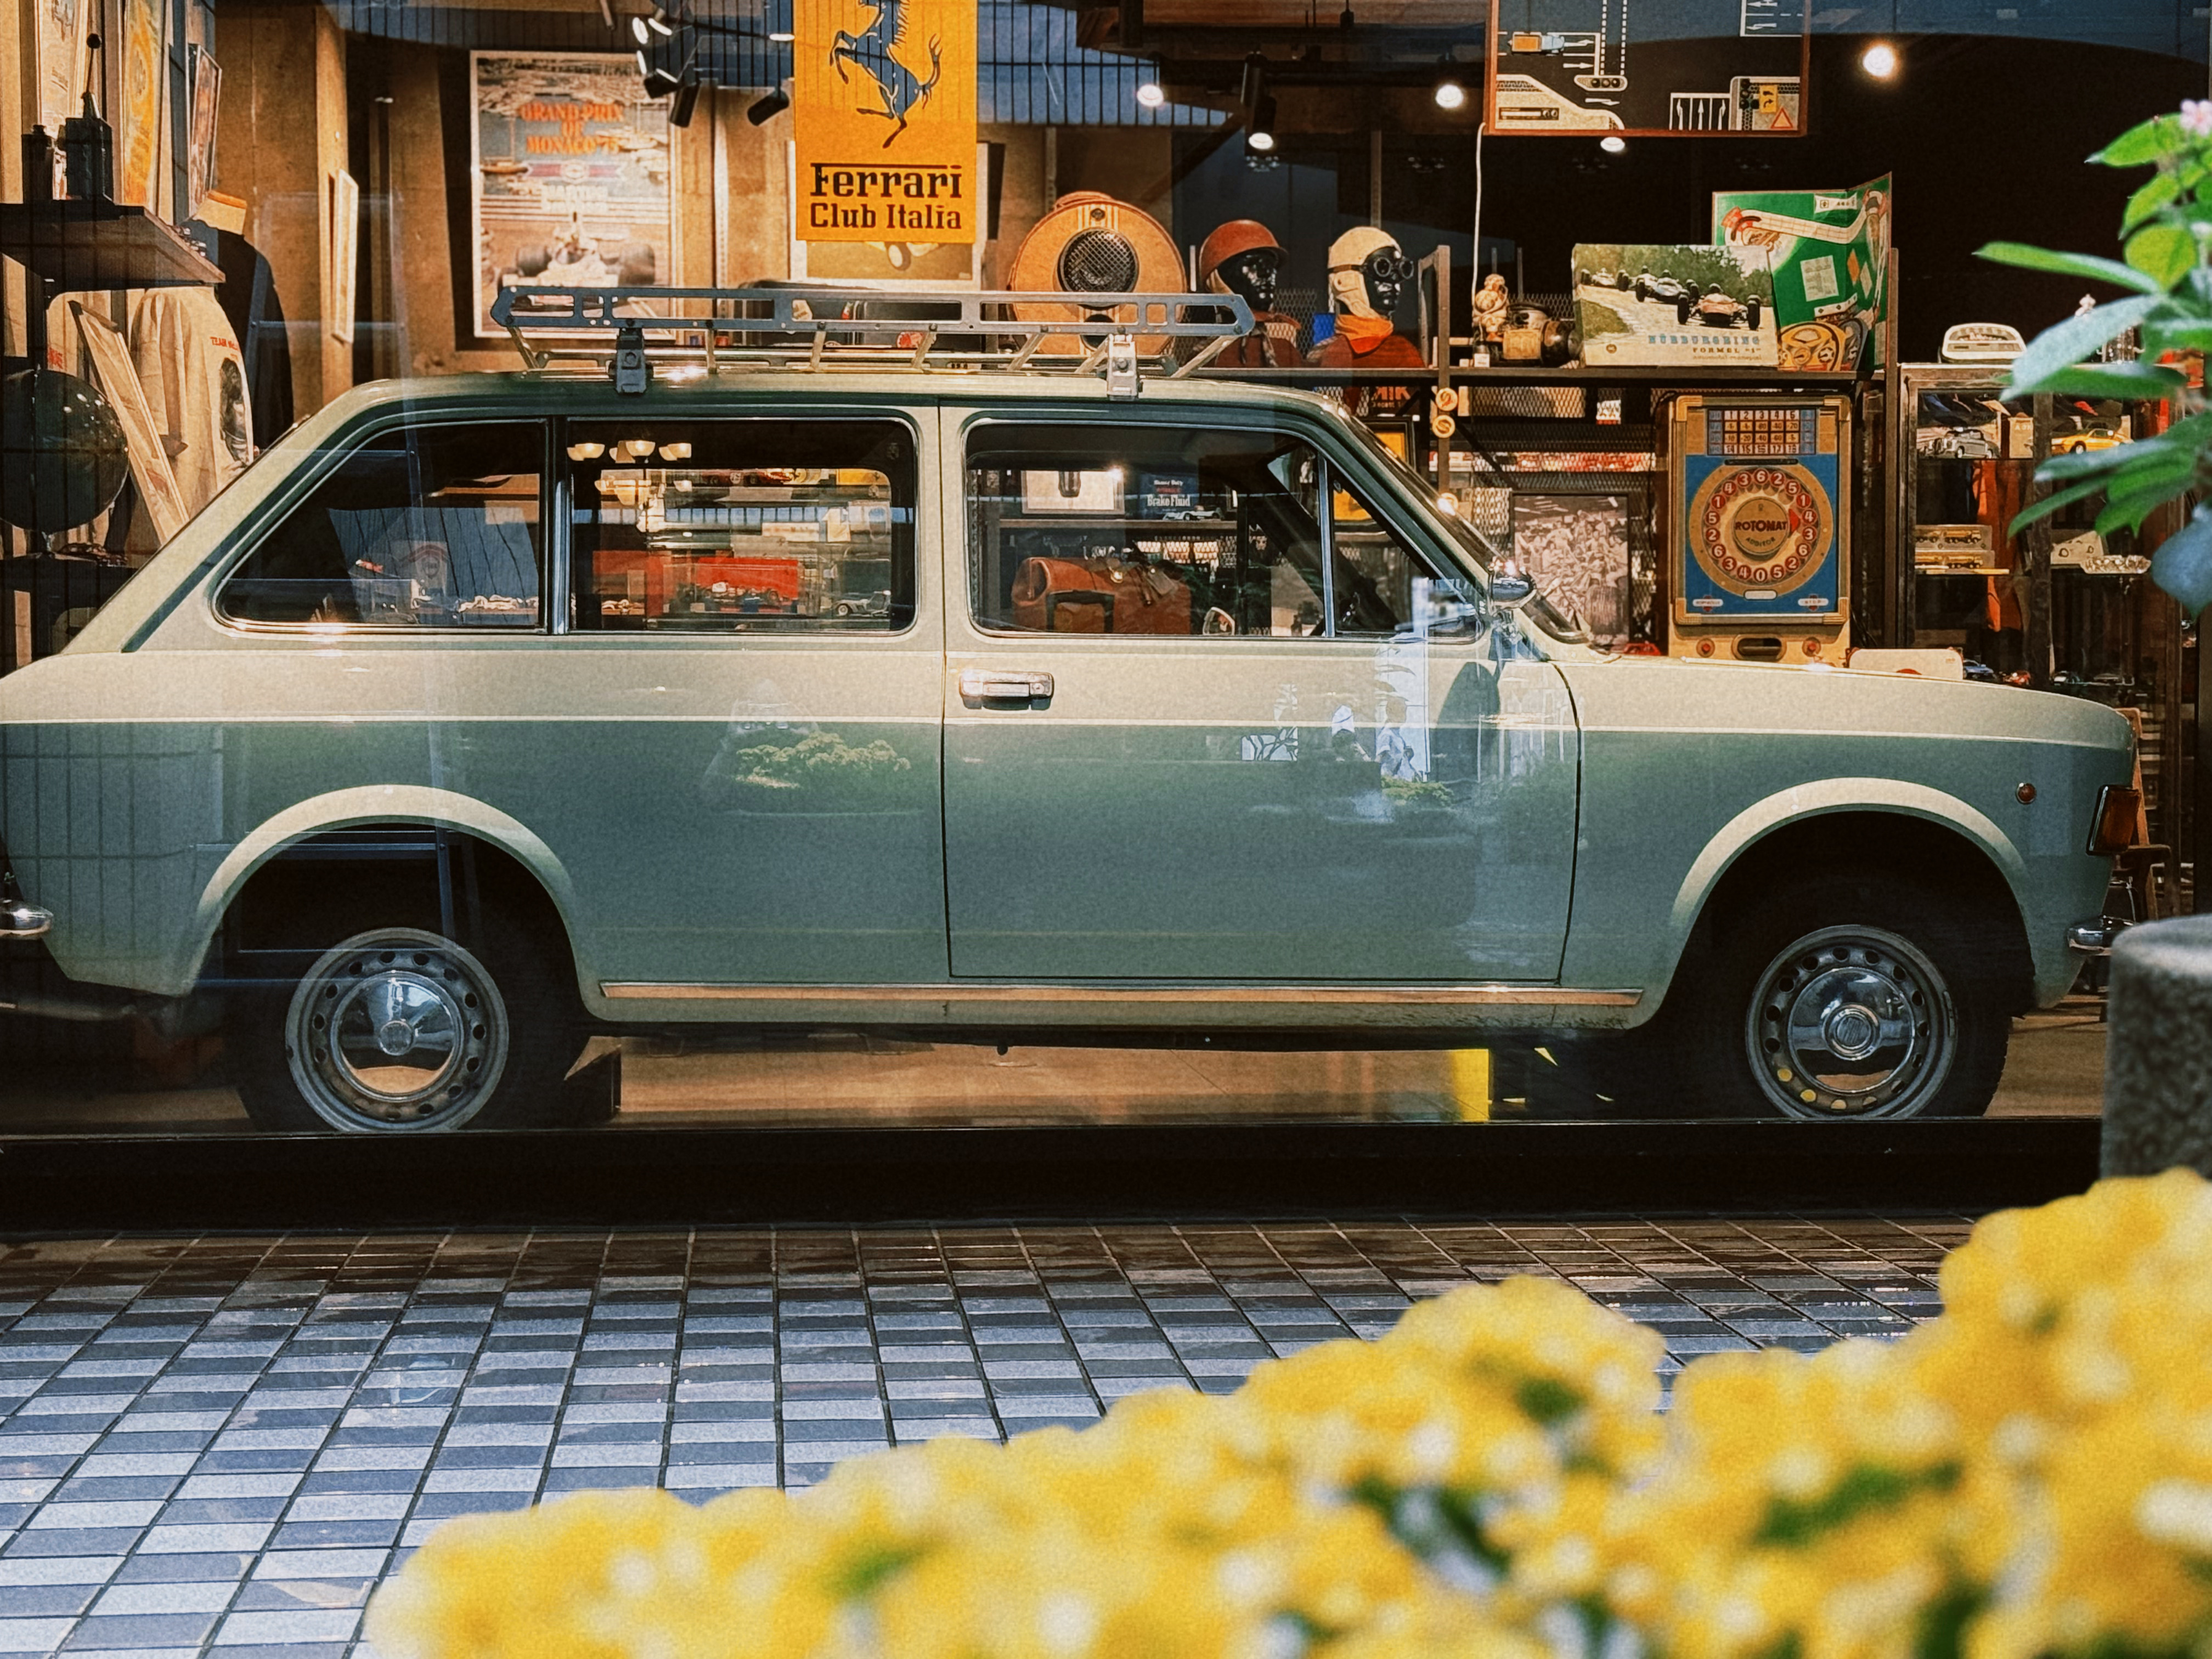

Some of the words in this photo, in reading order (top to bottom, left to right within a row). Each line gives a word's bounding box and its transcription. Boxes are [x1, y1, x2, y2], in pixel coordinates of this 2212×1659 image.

[810, 162, 962, 198] Ferrari
[810, 202, 877, 228] Club
[886, 204, 962, 229] Italia
[1743, 411, 1748, 420] 2
[1759, 411, 1764, 420] 3
[1790, 411, 1796, 420] 5
[1740, 473, 1748, 485] 3
[1757, 471, 1765, 482] 6
[1774, 472, 1782, 484] 2
[1725, 483, 1733, 493] 4
[1788, 482, 1797, 493] 5
[1147, 494, 1170, 506] Brake
[1170, 494, 1190, 506] Fluid
[1709, 512, 1717, 523] 5
[1805, 511, 1813, 522] 4
[1735, 520, 1788, 532] ROTOMAT
[1709, 529, 1717, 540] 2
[1805, 528, 1813, 540] 3
[1714, 545, 1723, 557] 6
[1799, 544, 1808, 556] 6
[1725, 558, 1734, 570] 3
[1788, 557, 1797, 568] 2
[1739, 567, 1747, 578] 4
[1756, 569, 1765, 582] 0
[1774, 567, 1782, 578] 5
